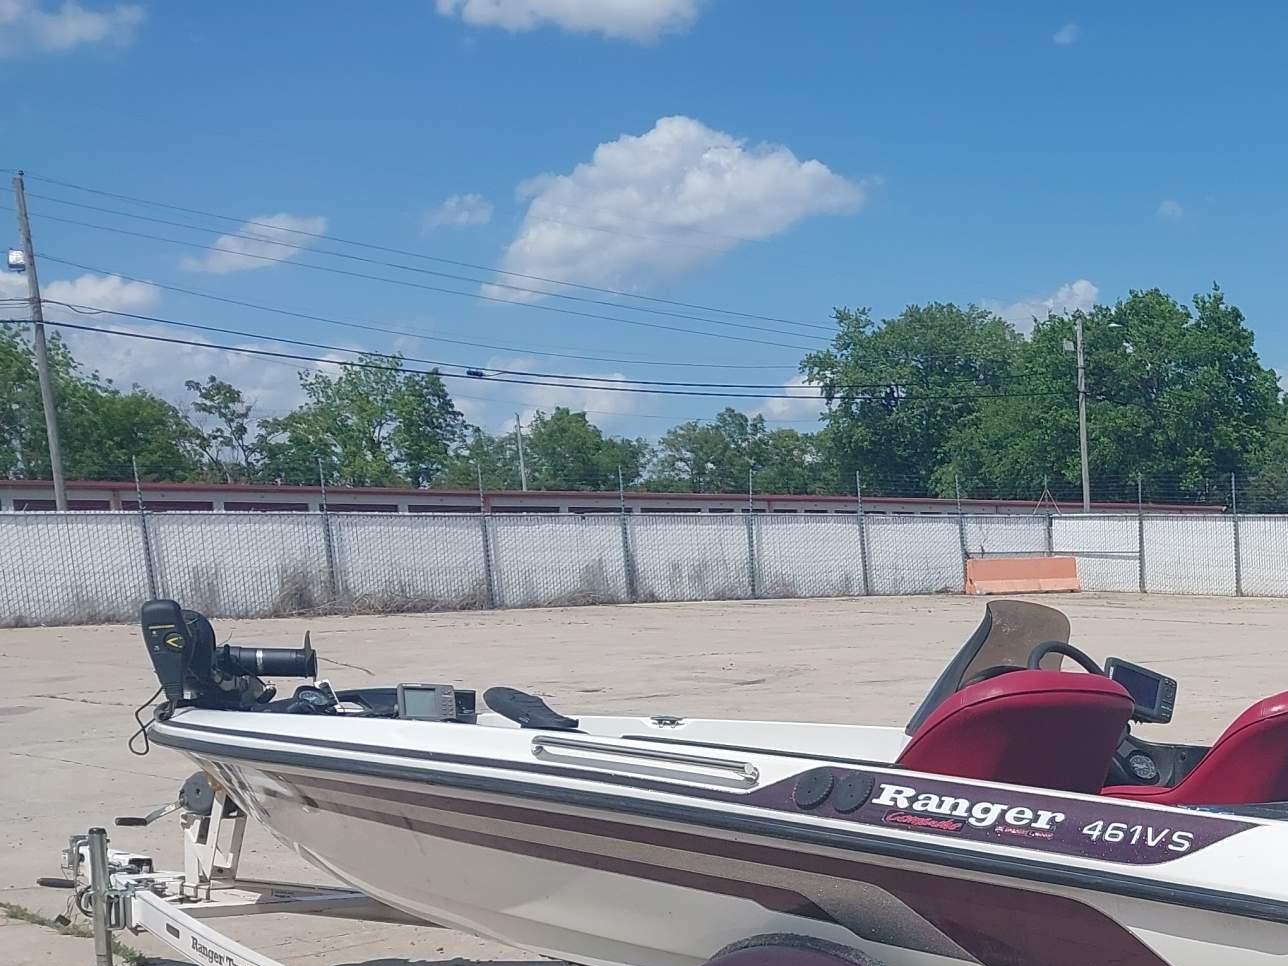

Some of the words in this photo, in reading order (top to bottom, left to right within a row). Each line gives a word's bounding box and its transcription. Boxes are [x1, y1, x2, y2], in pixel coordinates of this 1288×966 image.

[872, 784, 1065, 828] Ranger
[1082, 820, 1194, 852] 461VS
[191, 936, 225, 965] Ranger
